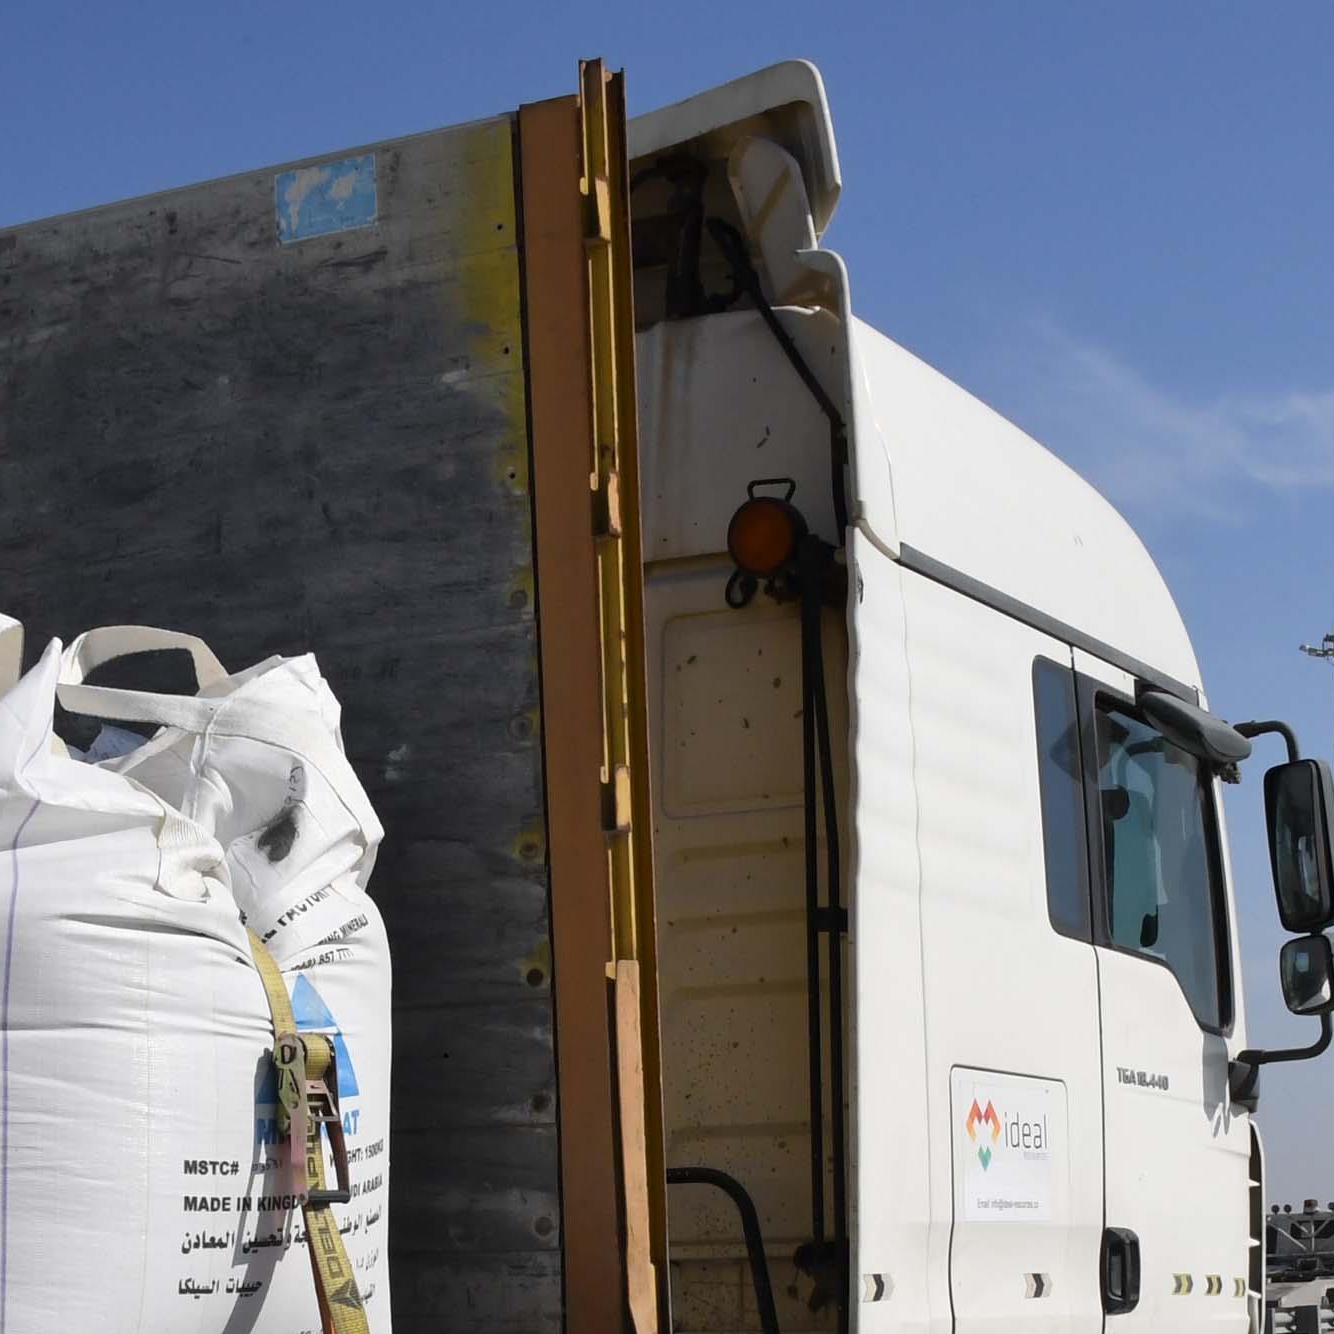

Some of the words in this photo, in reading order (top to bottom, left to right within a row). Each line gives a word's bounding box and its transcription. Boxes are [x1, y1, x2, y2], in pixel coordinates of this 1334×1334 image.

[1004, 1111, 1048, 1150] ideal
[183, 1160, 240, 1176] MSTC#
[183, 1196, 231, 1212] MADE
[236, 1196, 252, 1212] IN
[180, 1229, 236, 1254] المعادن
[178, 1278, 220, 1299] السيلكا
[226, 1277, 263, 1297] حبيبات
